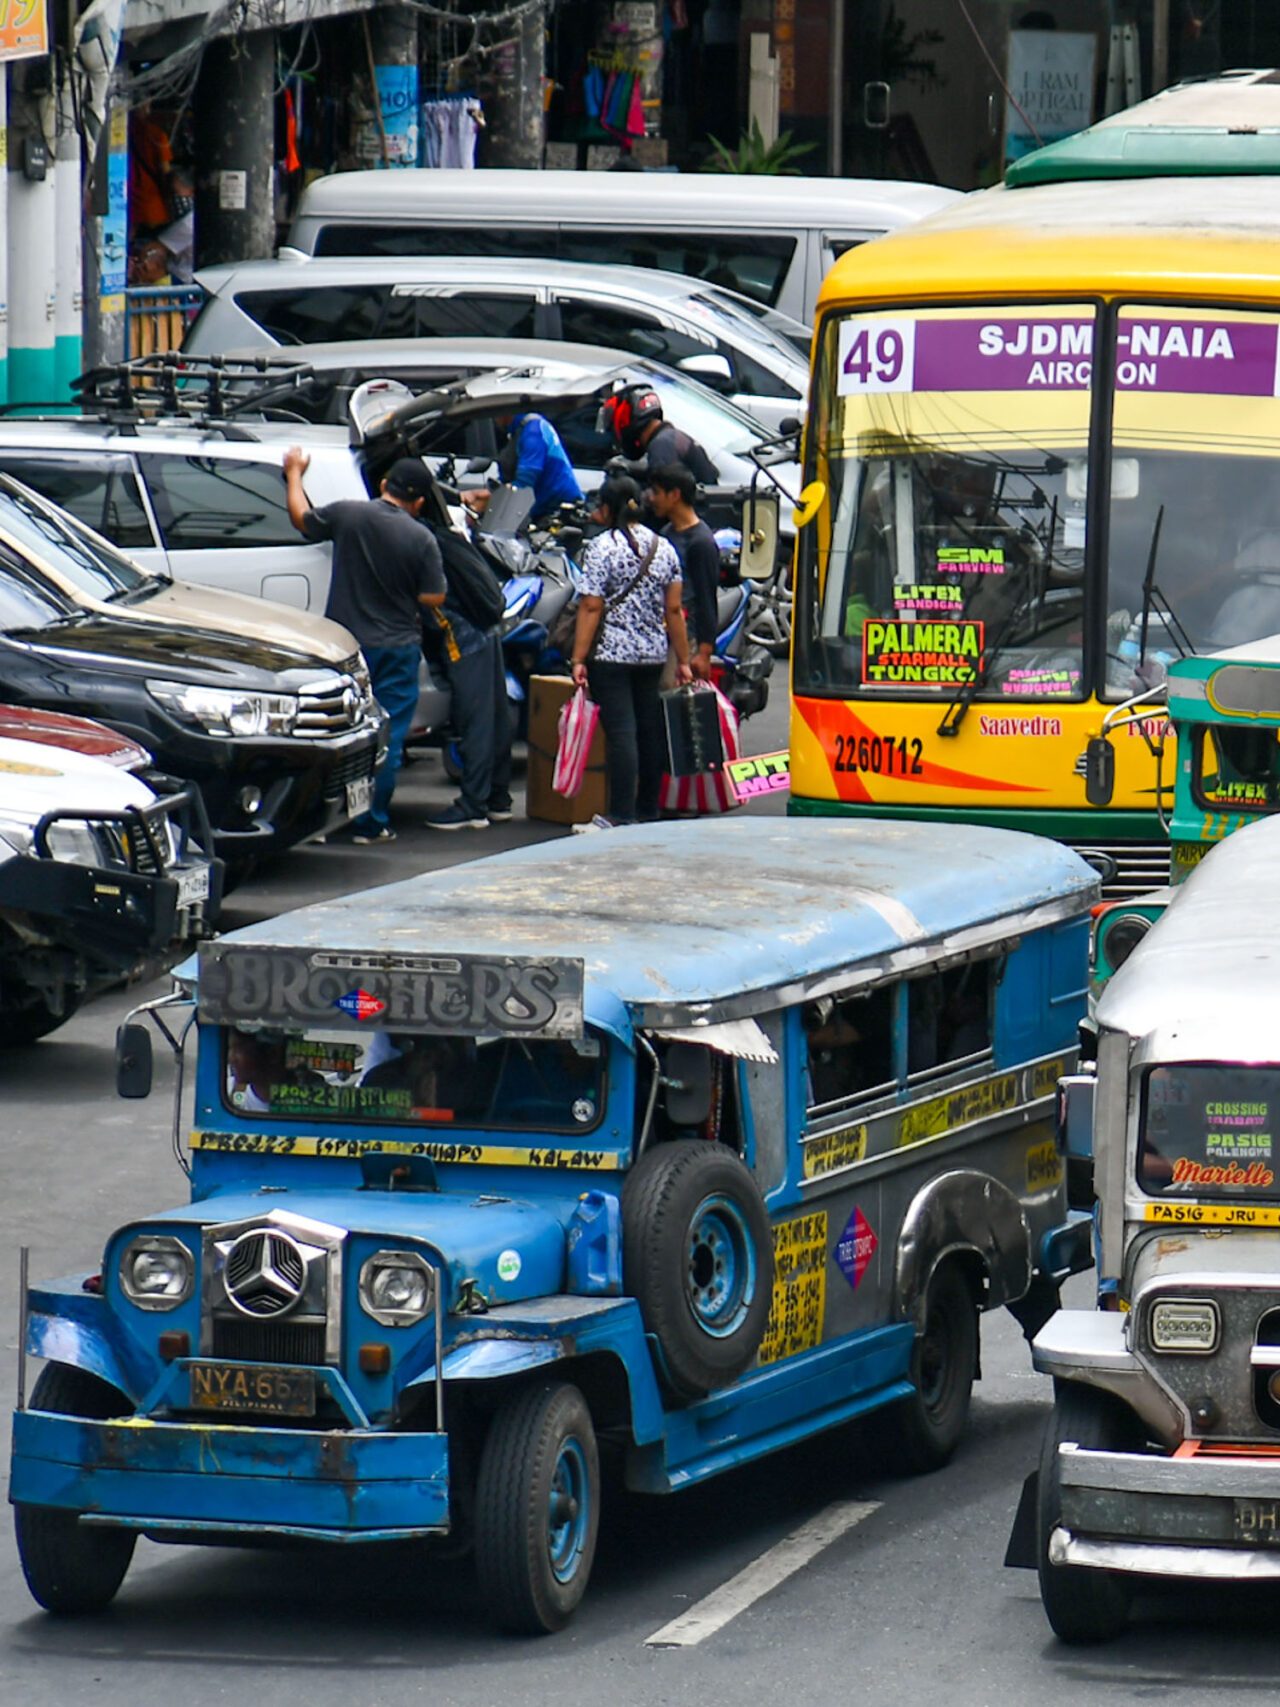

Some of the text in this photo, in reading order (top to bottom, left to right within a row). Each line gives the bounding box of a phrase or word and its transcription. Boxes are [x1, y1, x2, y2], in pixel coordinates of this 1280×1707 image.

[843, 328, 903, 384] 49
[936, 548, 1005, 564] SM
[893, 585, 963, 601] LITEX
[867, 623, 979, 658] PALMERA
[878, 652, 970, 667] STARMALL
[979, 715, 1062, 736] Saavedra
[1215, 782, 1267, 799] LITEX
[1205, 1102, 1268, 1117] CROSSING
[1206, 1134, 1273, 1147] PASIG
[528, 1148, 604, 1168] KALAW
[1172, 1156, 1274, 1187] Marielle
[1153, 1205, 1204, 1222] PASIG
[1225, 1210, 1256, 1223] JRU
